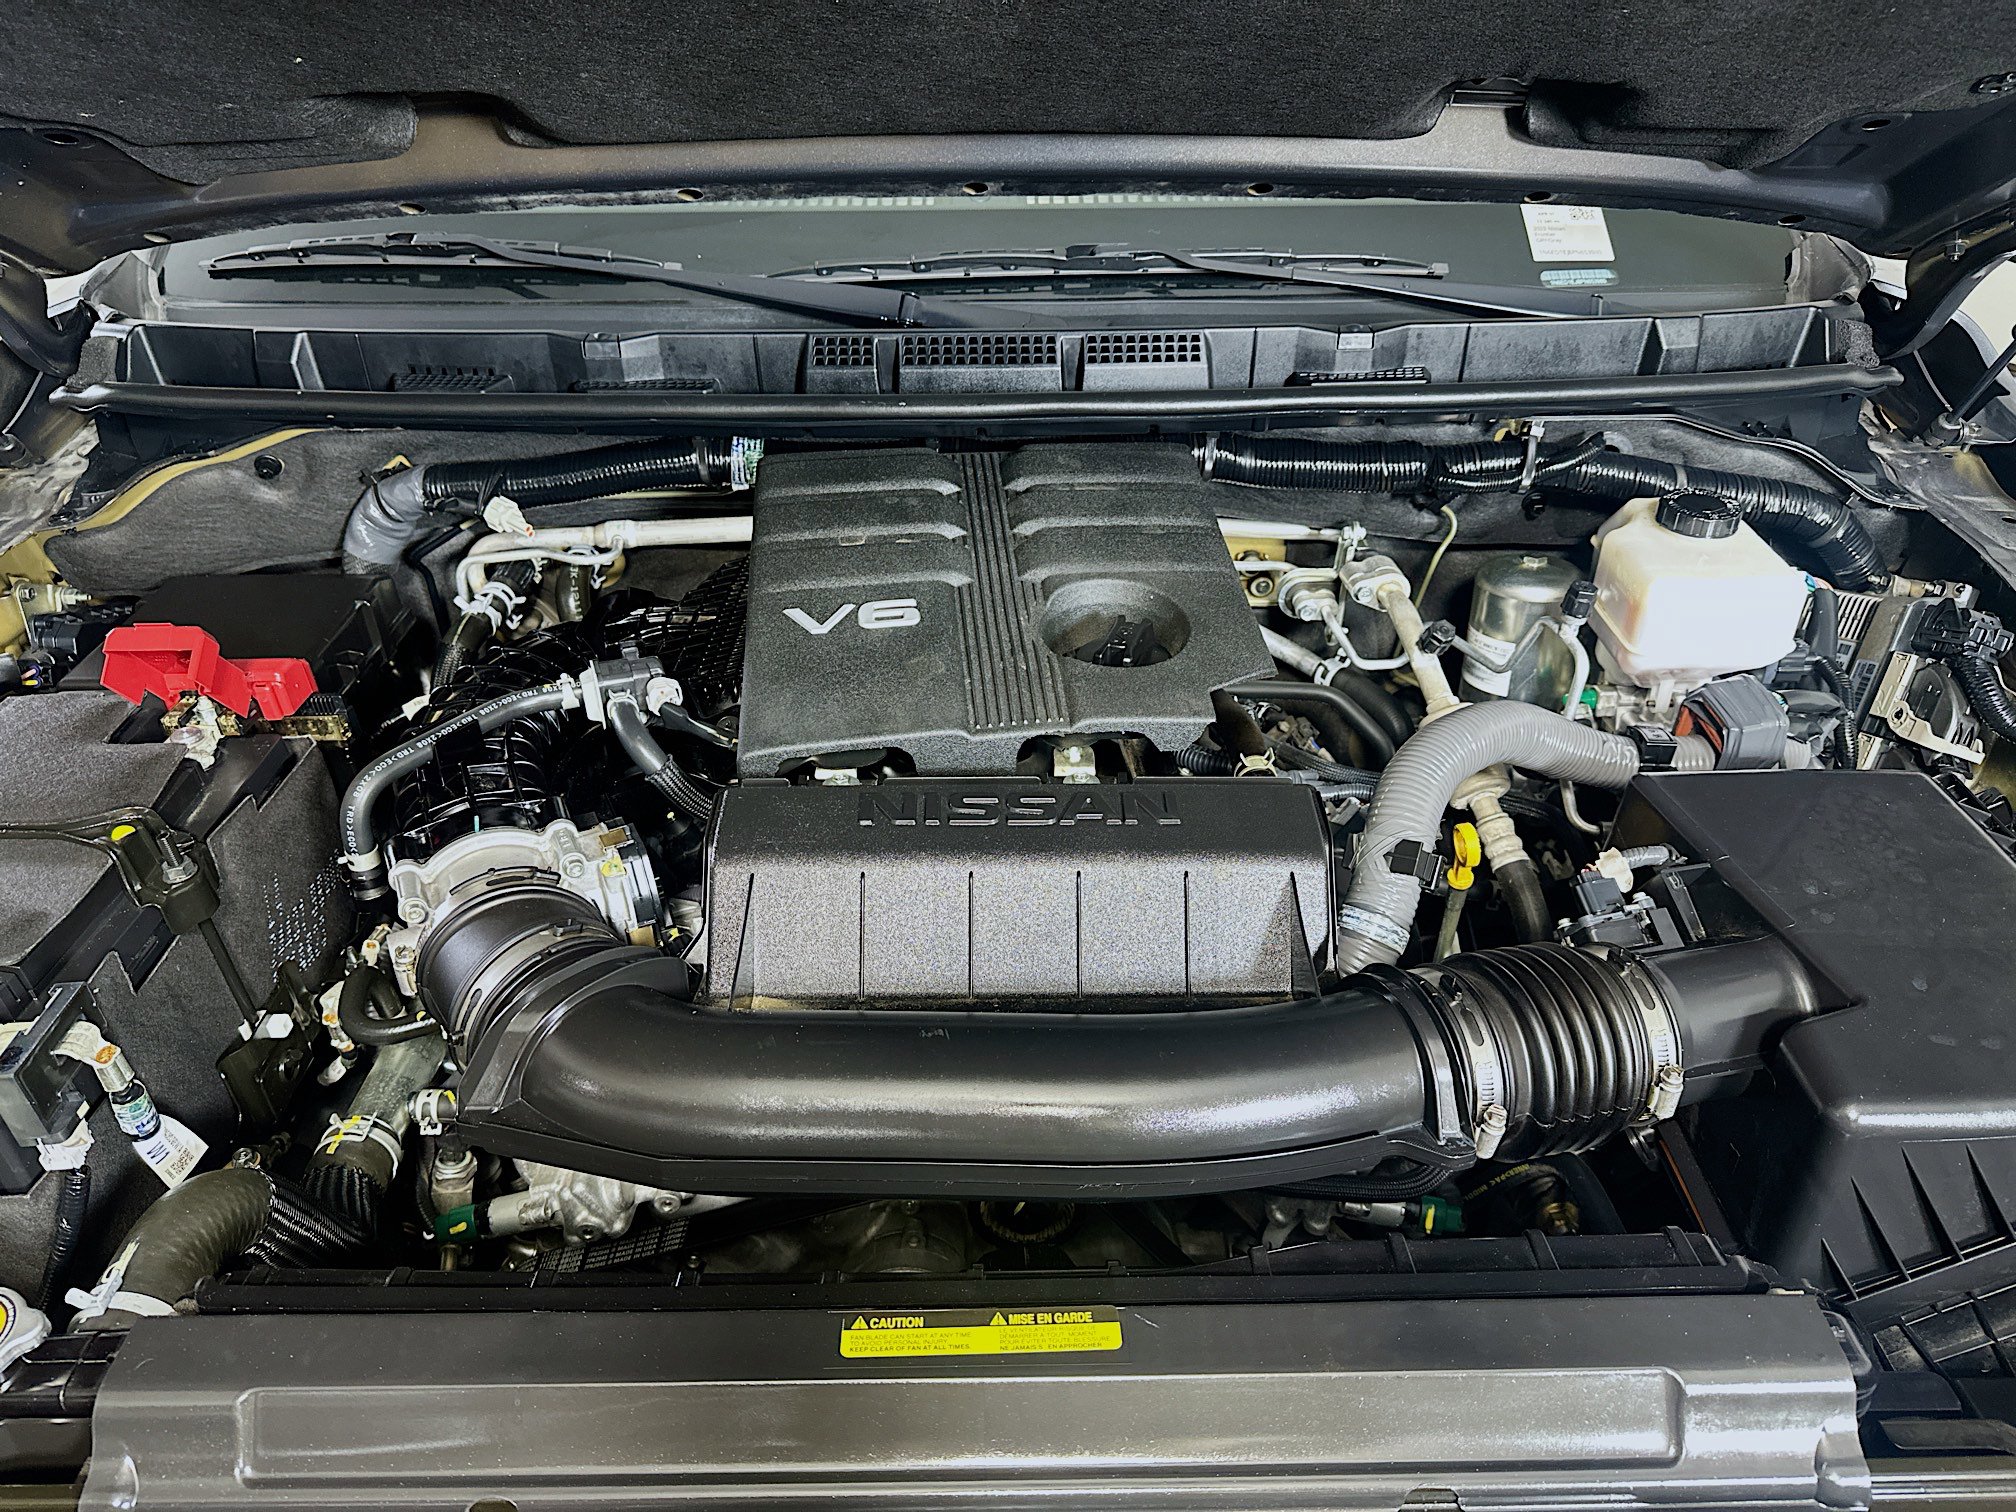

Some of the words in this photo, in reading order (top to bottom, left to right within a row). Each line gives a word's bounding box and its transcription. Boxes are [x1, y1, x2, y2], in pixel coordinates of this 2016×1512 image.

[782, 598, 922, 635] V6
[858, 791, 1182, 827] NISSAN
[869, 1316, 924, 1329] CAUTION
[1008, 1313, 1035, 1325] MISE
[1037, 1312, 1052, 1324] EN
[1053, 1311, 1093, 1324] GARDE
